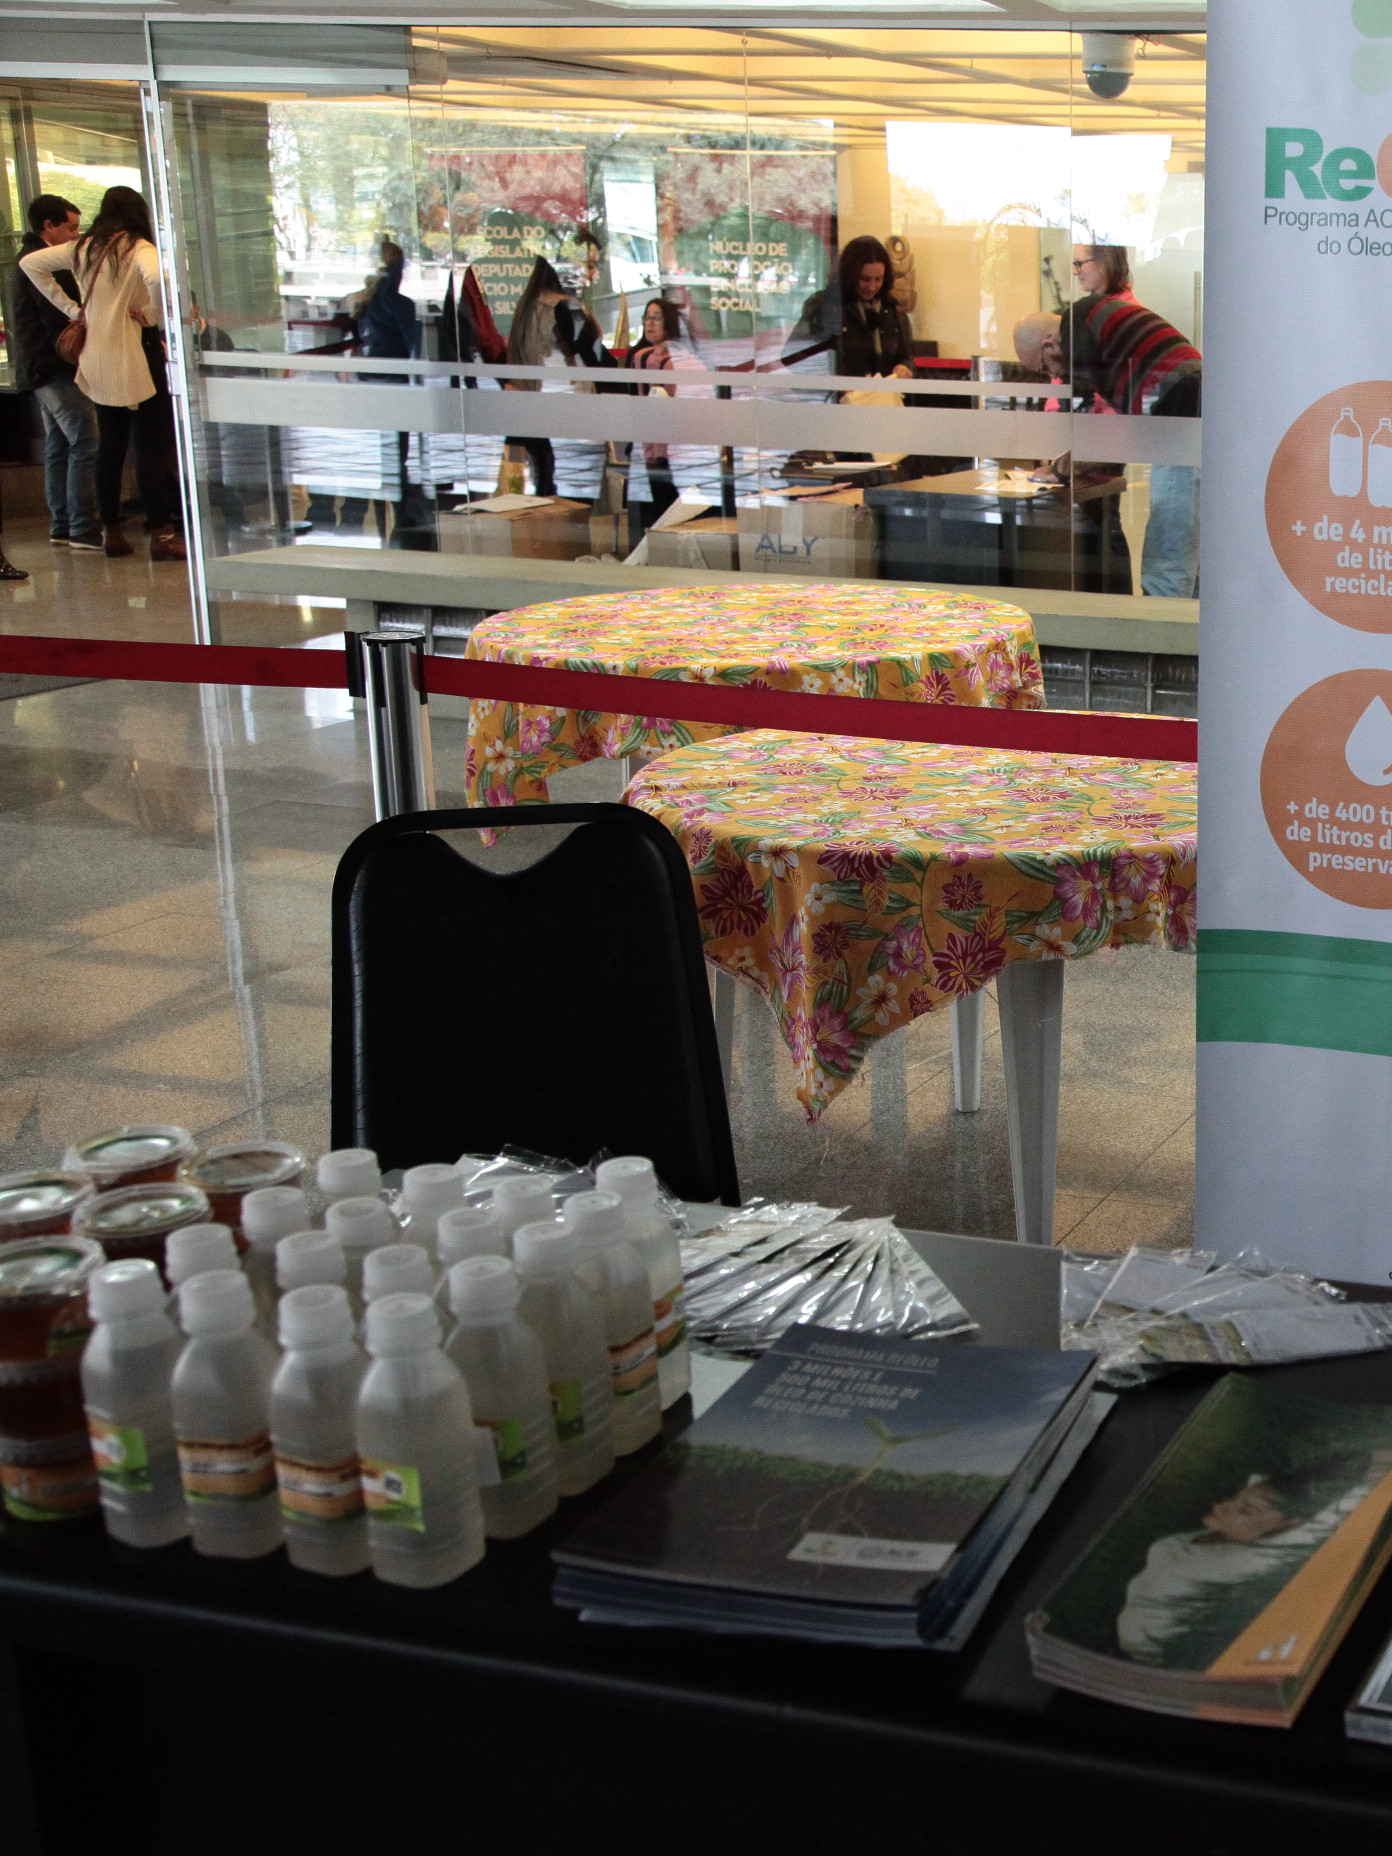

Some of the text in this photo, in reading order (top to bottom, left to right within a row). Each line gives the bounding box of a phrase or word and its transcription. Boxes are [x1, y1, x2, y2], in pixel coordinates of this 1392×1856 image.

[1264, 206, 1359, 231] Programa
[709, 237, 788, 256] NÚCLEO DE
[1317, 236, 1341, 255] do
[709, 296, 761, 312] SOCIAL
[1313, 514, 1344, 541] de
[1350, 519, 1366, 543] 4
[1336, 545, 1363, 569] de
[1304, 797, 1330, 820] de
[1335, 801, 1375, 824] 400
[1286, 820, 1312, 842] de
[1317, 822, 1374, 849] litros
